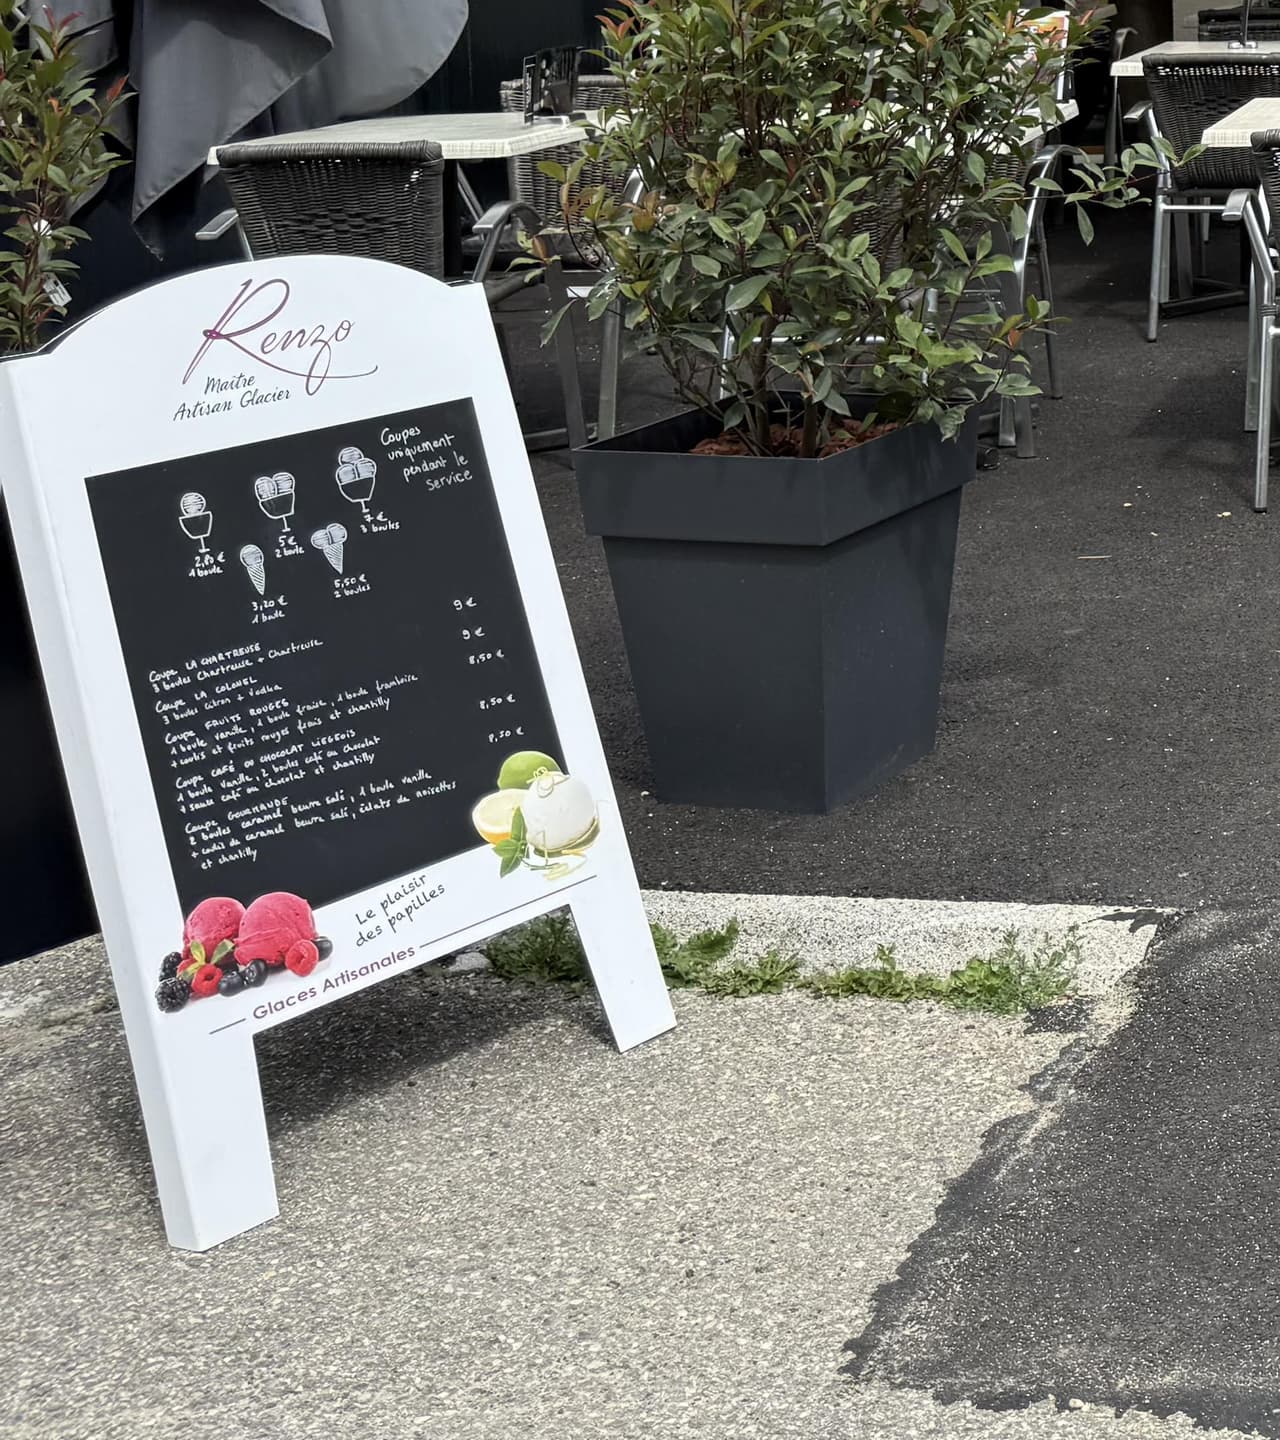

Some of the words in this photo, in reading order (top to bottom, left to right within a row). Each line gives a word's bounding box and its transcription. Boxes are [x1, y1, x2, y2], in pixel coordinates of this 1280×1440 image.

[182, 278, 378, 396] Renzo
[173, 399, 232, 421] Artisan
[240, 387, 291, 408] Glacier
[381, 426, 421, 446] Coupes
[388, 433, 455, 462] uniquement
[403, 456, 447, 482] pendant
[453, 451, 468, 466] le
[149, 668, 178, 683] Coupe
[185, 659, 198, 671] LA
[200, 642, 261, 666] CHARTREUSE
[163, 676, 191, 691] boules
[196, 659, 253, 681] Chartreuse
[268, 639, 324, 659] Chartreuse
[155, 699, 186, 713] Coupe
[194, 690, 208, 701] LA
[215, 676, 258, 694] COLONEL
[165, 729, 196, 744] Coupe
[249, 698, 289, 716] ROUGES
[180, 737, 207, 752] boule
[267, 710, 290, 724] boule
[212, 744, 223, 755] et
[261, 727, 290, 743] rouges
[297, 719, 322, 734] frais
[329, 709, 341, 720] et
[348, 696, 390, 711] chantilly
[176, 775, 204, 788] Coupe
[260, 744, 304, 763] CHOCOLAT
[188, 784, 213, 799] boule
[273, 760, 299, 773] boules
[265, 771, 306, 788] chocolat
[314, 765, 325, 775] et
[332, 752, 375, 771] chantilly
[201, 826, 231, 841] boules
[241, 807, 283, 829] caramel
[401, 769, 432, 784] vanille
[245, 823, 285, 841] caramel
[416, 780, 457, 798] noisettes
[185, 820, 218, 834] Coupe
[201, 859, 212, 869] et
[218, 846, 257, 864] chantilly
[355, 908, 376, 925] Le
[380, 874, 427, 917] plaisir
[355, 924, 384, 948] des
[388, 883, 446, 934] papilles
[253, 985, 317, 1019] Glaces
[322, 945, 416, 993] Artisanales
